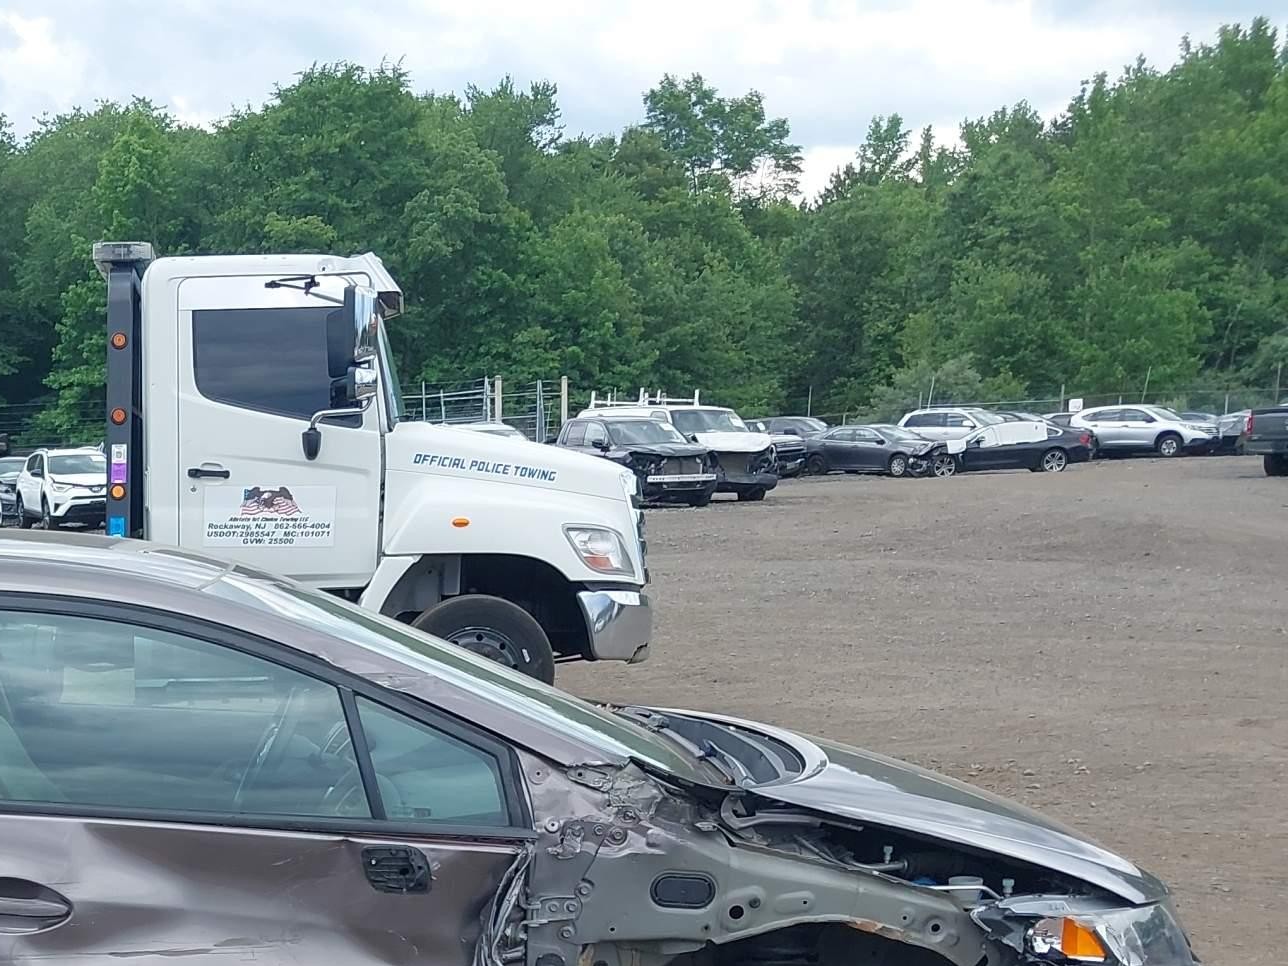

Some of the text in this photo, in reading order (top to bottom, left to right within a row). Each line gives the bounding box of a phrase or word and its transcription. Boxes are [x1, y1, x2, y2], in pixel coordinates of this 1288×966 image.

[413, 453, 557, 482] OFFICIAL POLICE TOWING
[208, 522, 252, 532] Rockaway,
